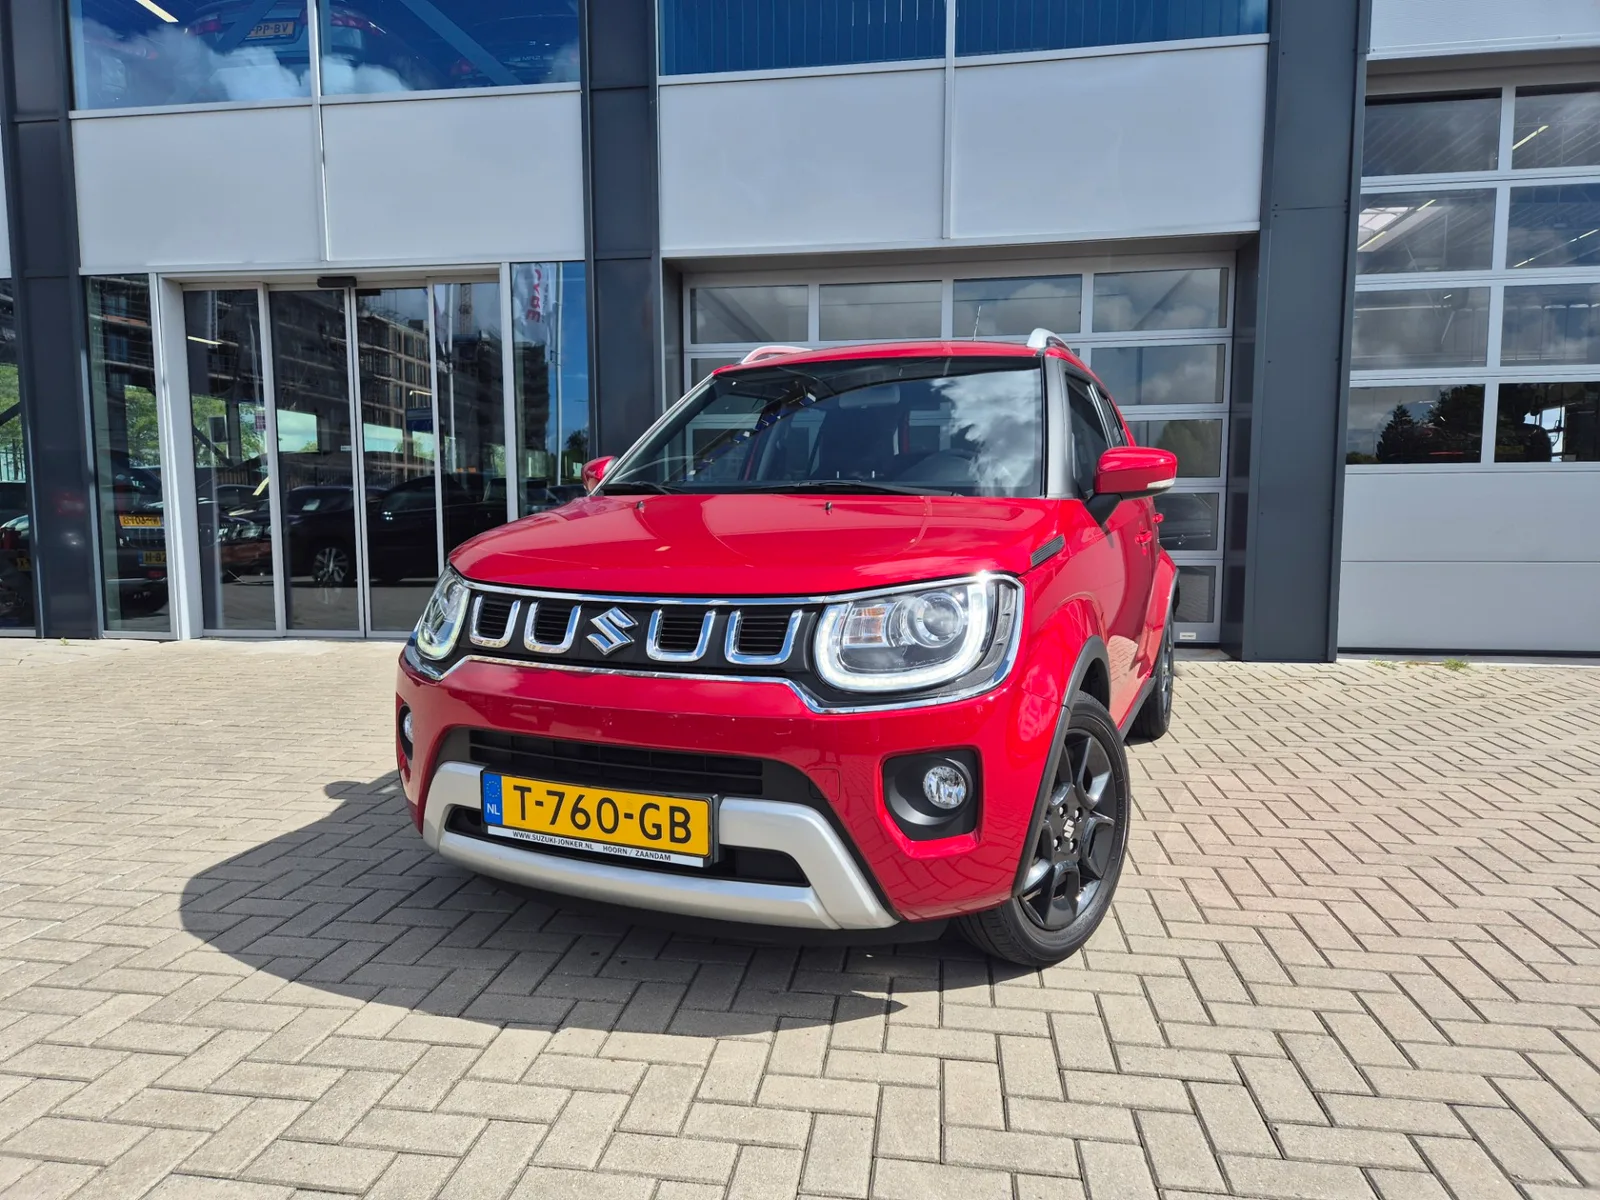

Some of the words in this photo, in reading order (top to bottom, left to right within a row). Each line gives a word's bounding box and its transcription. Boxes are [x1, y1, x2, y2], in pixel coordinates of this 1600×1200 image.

[486, 803, 500, 815] NL
[513, 785, 692, 844] T-760-GB
[602, 845, 628, 855] HOORN
[635, 850, 671, 862] ZAANDAM
